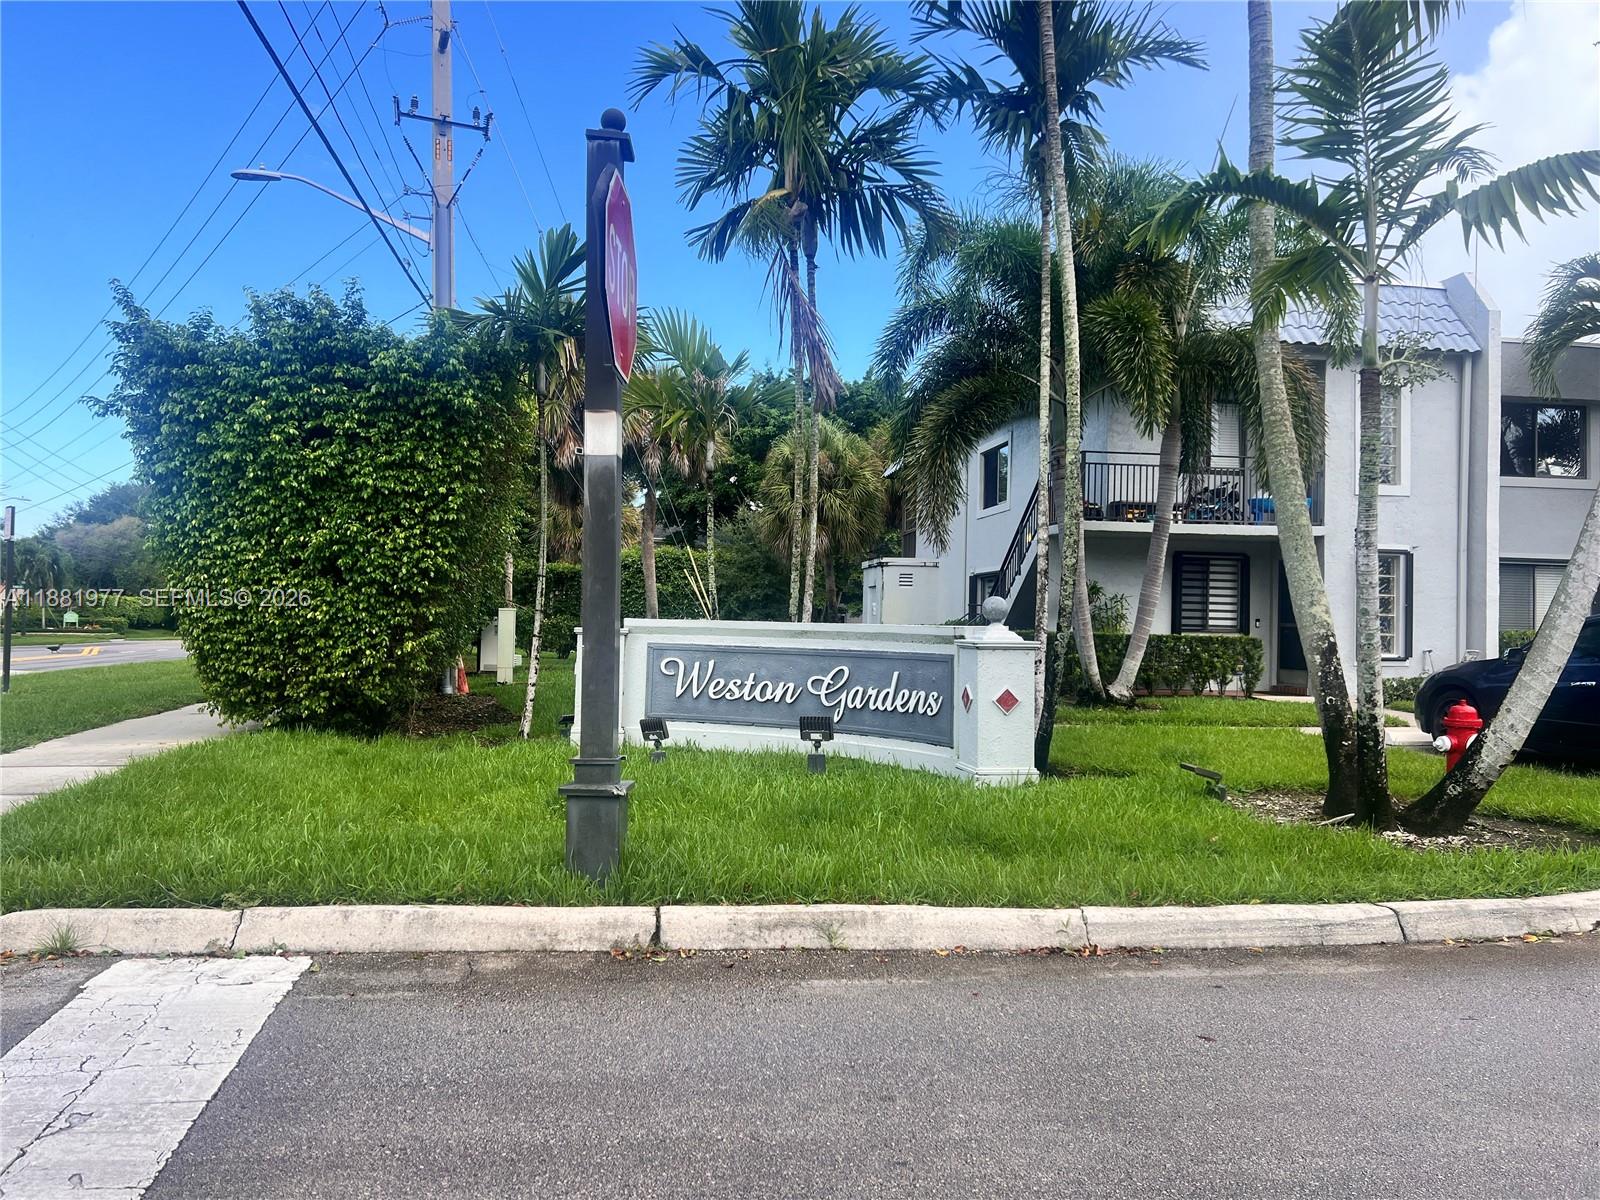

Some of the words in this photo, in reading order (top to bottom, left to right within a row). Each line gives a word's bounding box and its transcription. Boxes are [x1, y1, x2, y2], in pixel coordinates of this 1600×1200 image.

[608, 223, 635, 325] STOP
[660, 656, 802, 704] Weston
[806, 665, 943, 723] Gardens
